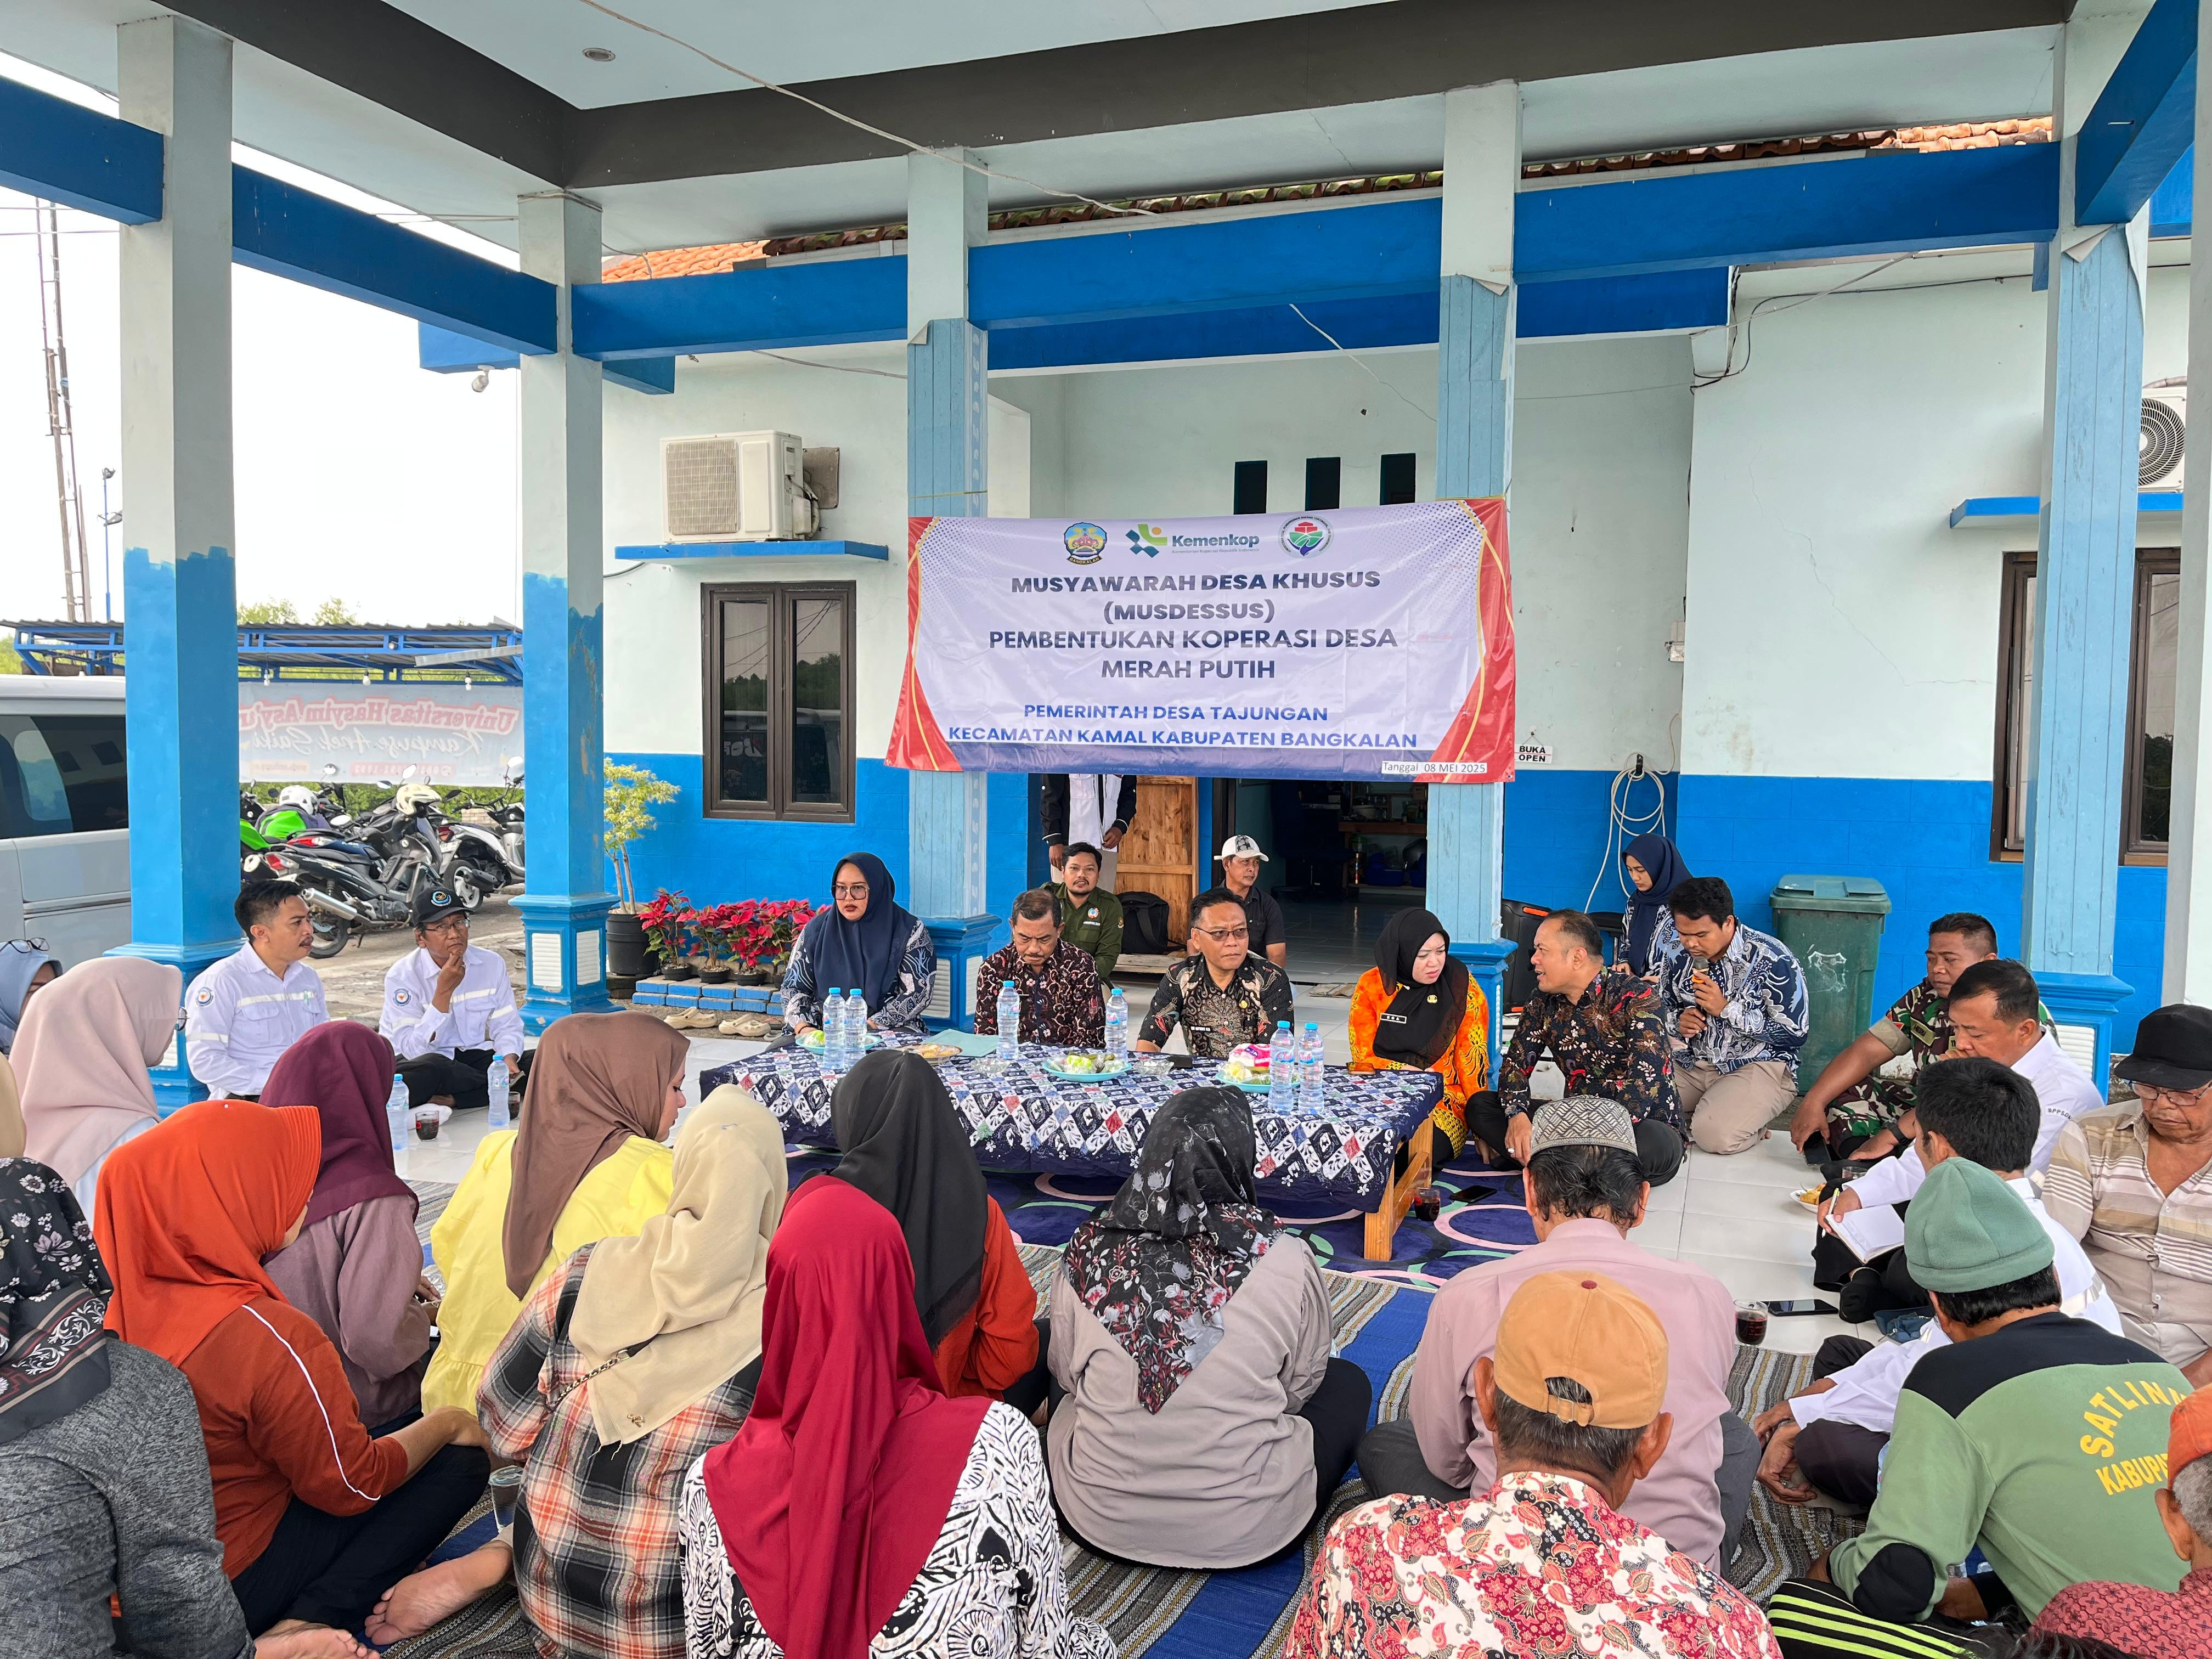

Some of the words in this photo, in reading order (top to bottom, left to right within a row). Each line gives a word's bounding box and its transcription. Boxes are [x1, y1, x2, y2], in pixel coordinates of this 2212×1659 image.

[1172, 534, 1260, 548] Kemenkop
[1011, 575, 1196, 593] MUSYAWARAH
[1201, 574, 1267, 590] DESA
[1272, 571, 1381, 589] KHUSUS
[1104, 599, 1275, 624] (MUSDESSUS)
[989, 630, 1175, 650] PEMBENTUKAN
[1182, 629, 1317, 648] KOPERASI
[1326, 628, 1398, 647] DESA
[1101, 660, 1192, 678] MERAH
[1199, 660, 1276, 679] PUTIH
[1024, 704, 1147, 719] PEMERINTAH
[1153, 706, 1205, 720] DESA
[1210, 707, 1328, 721] TAJUNGAN
[949, 727, 1073, 742] KECAMATAN
[1077, 730, 1147, 743] KAMAL
[1152, 731, 1275, 746] KABUPATEN
[1281, 732, 1417, 748] BANGKALAN
[1519, 745, 1546, 754] BUKA
[1519, 754, 1546, 763] OPEN
[1383, 762, 1418, 774] Tanggal
[1424, 763, 1436, 772] 08
[1439, 764, 1458, 772] MEI
[1461, 764, 1486, 773] 2025
